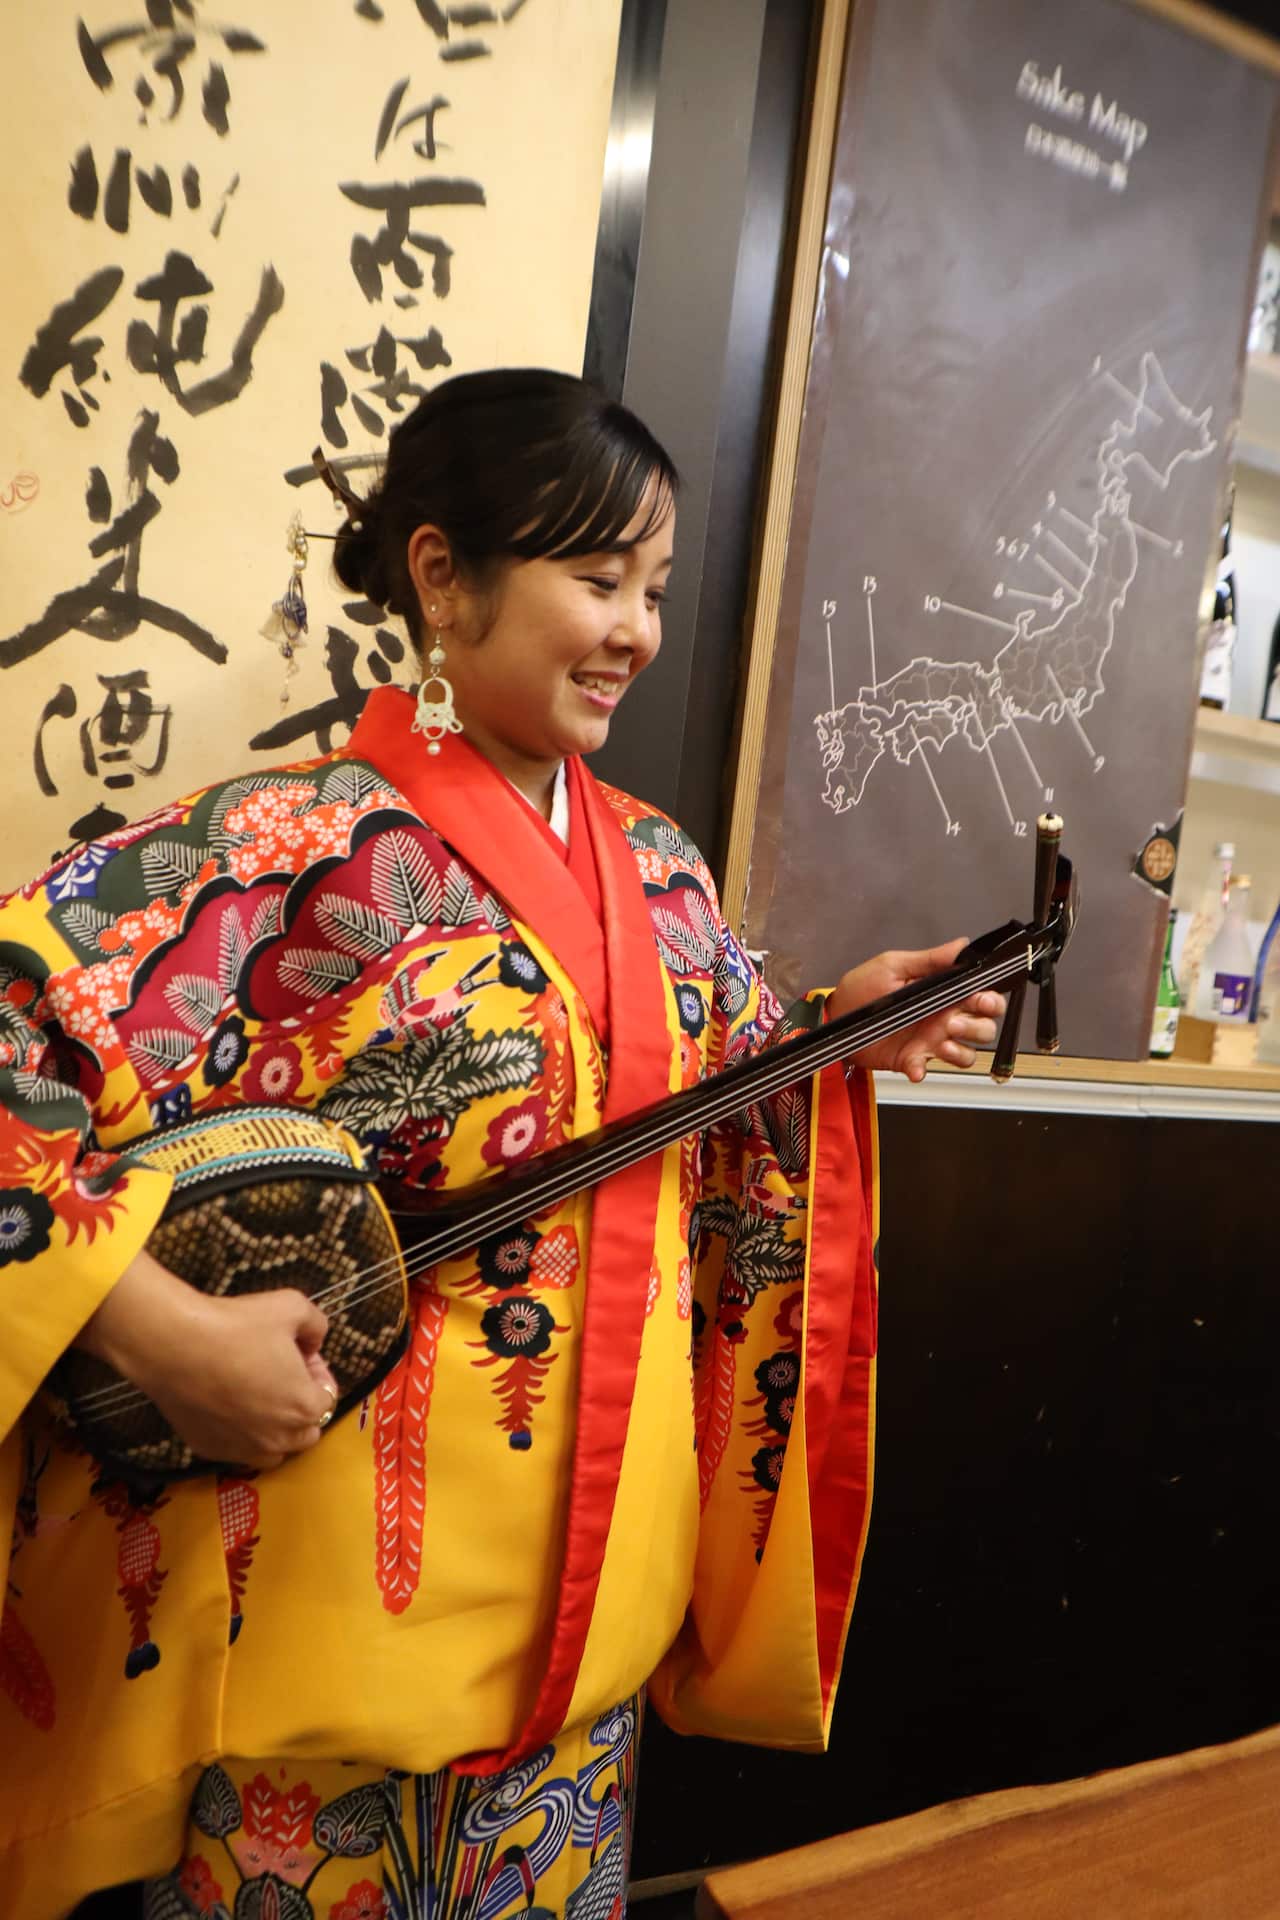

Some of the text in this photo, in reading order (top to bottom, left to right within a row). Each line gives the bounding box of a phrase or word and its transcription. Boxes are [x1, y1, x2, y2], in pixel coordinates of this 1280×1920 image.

[1089, 91, 1148, 161] Map
[1006, 537, 1019, 557] 6
[1017, 543, 1030, 562] 7
[822, 599, 837, 619] 15
[923, 594, 941, 613] 10
[1093, 754, 1105, 774] 9
[1044, 787, 1054, 803] 11
[945, 820, 961, 837] 14
[1014, 821, 1028, 837] 12
